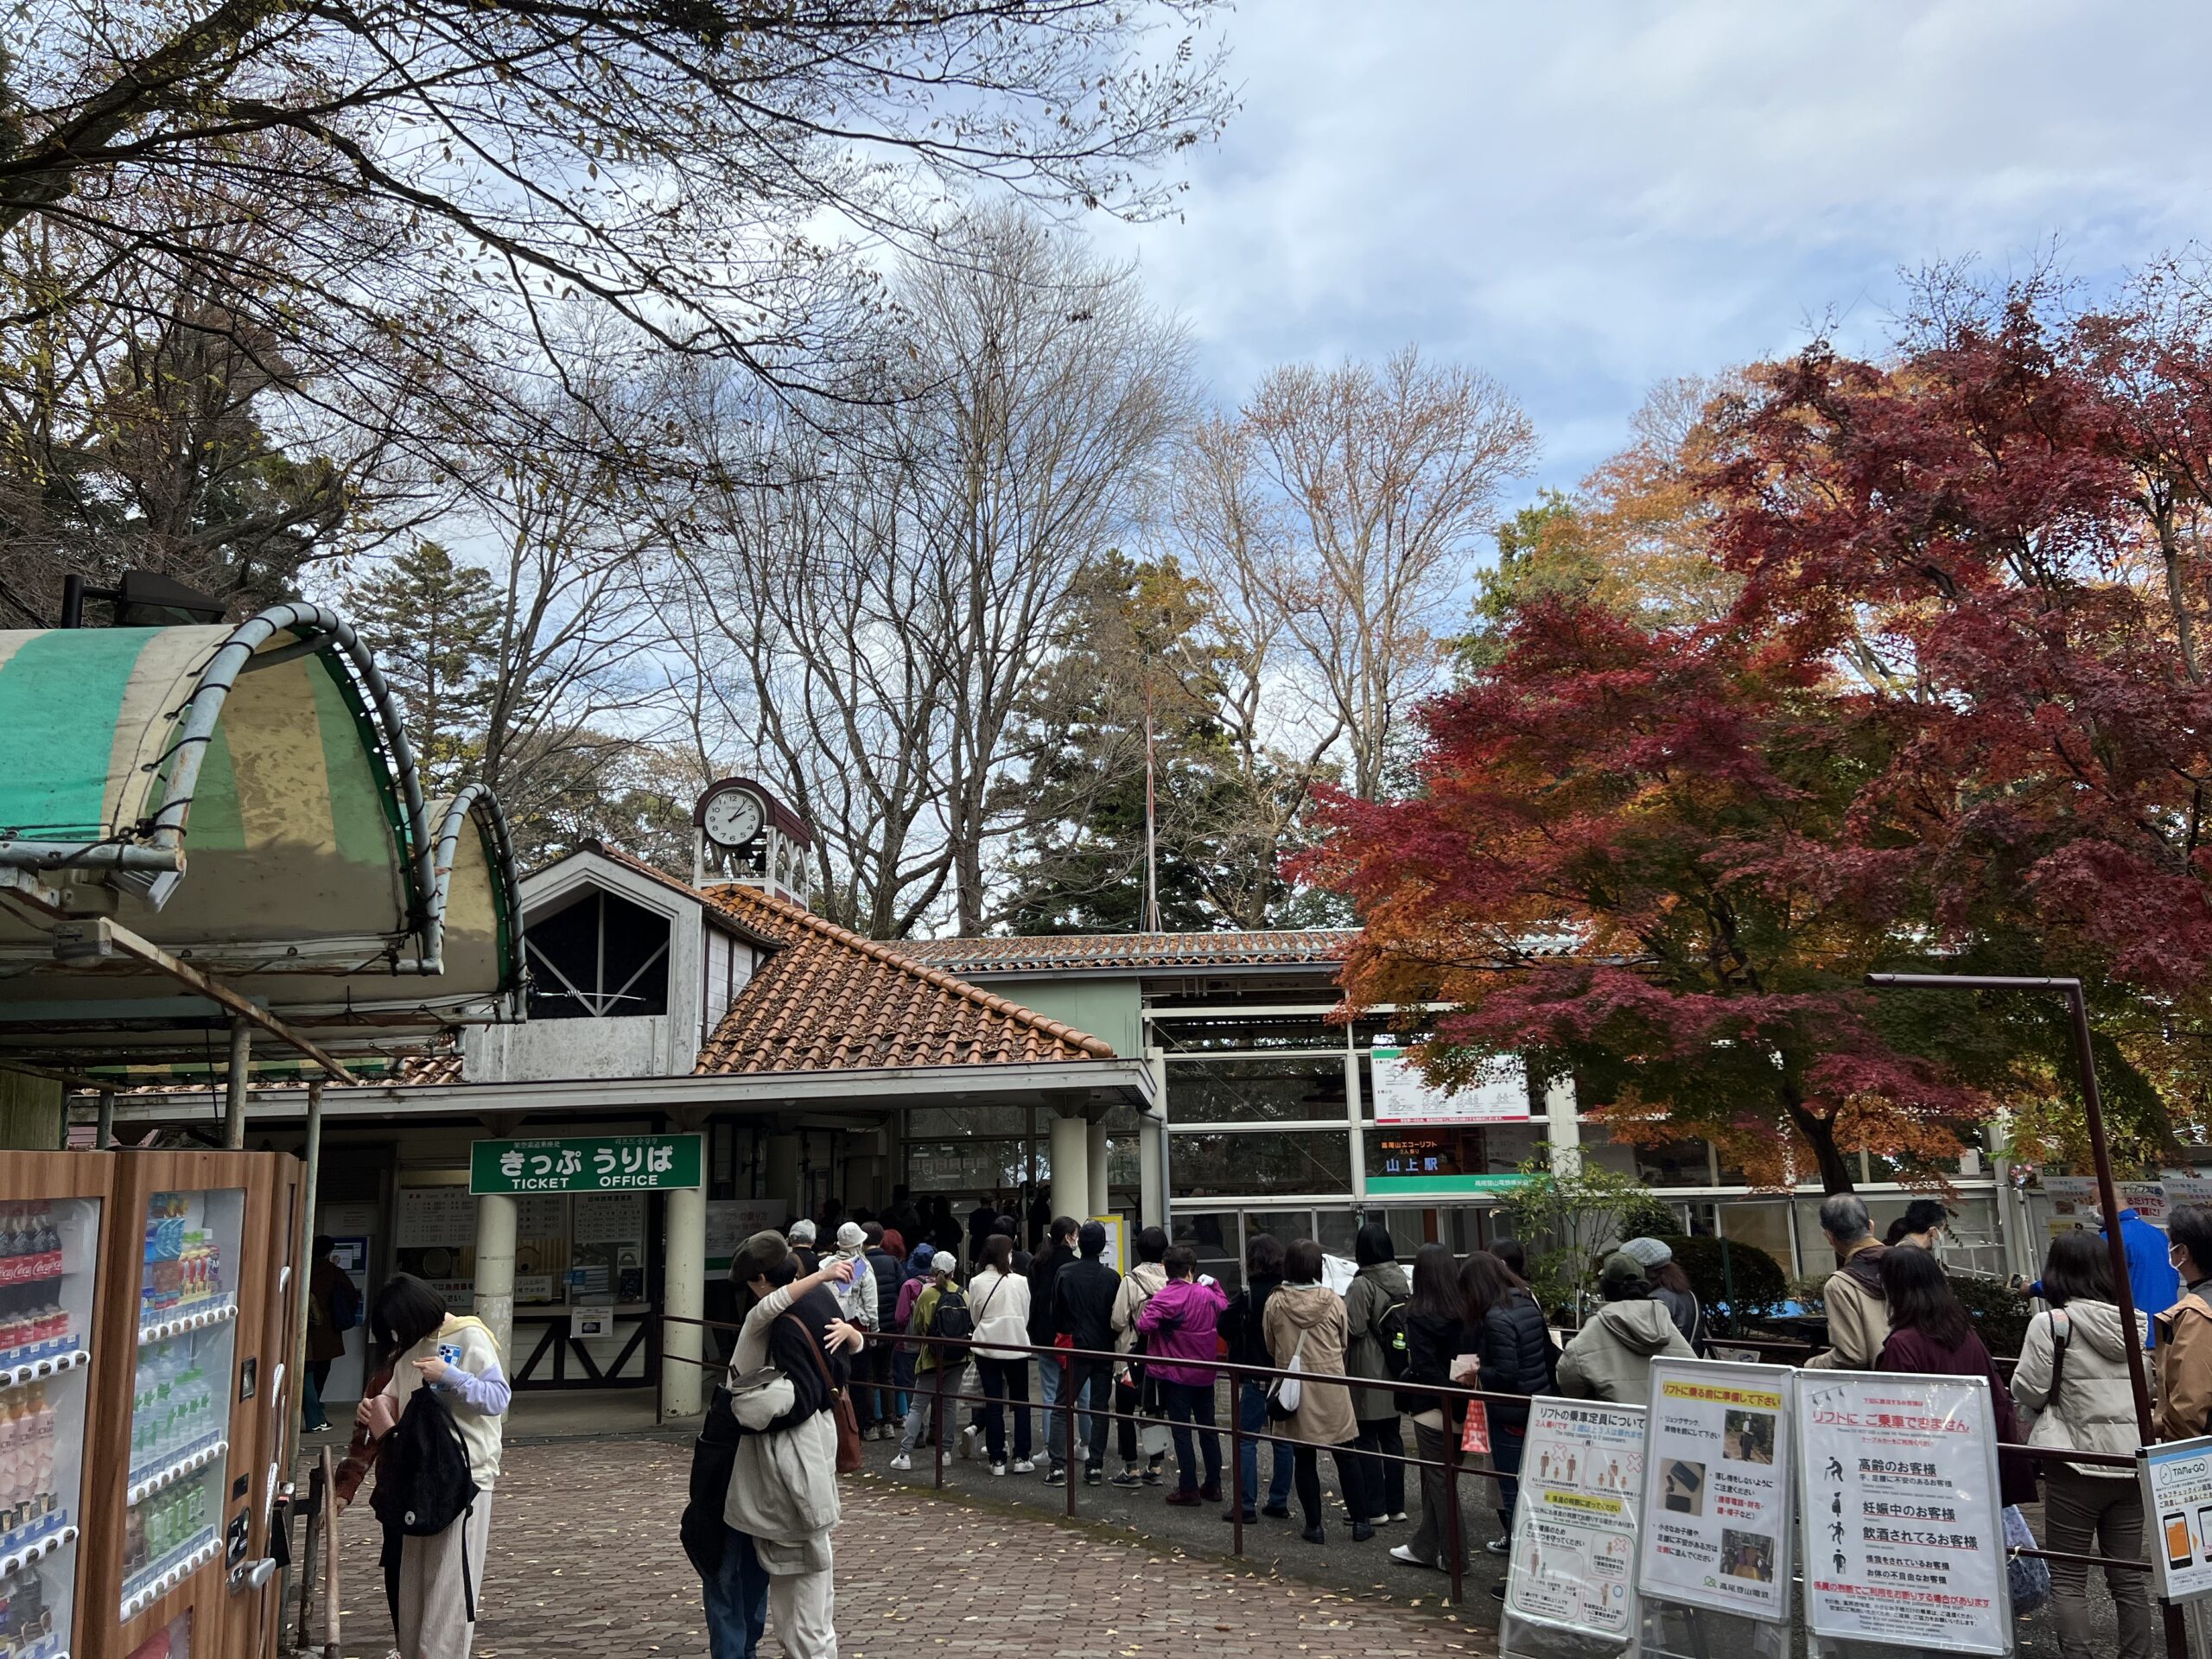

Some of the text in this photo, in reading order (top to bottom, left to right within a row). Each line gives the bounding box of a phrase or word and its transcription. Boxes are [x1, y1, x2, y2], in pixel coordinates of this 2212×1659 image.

[499, 1145, 673, 1177] きっぷ うりば
[1386, 1157, 1438, 1173] 山上駅
[512, 1174, 658, 1189] TICKET OFFICE
[1662, 1383, 1781, 1407] リフトに乗る前に準備して下さい
[1540, 1407, 1646, 1429] リフトの乗車定員について
[1813, 1410, 1859, 1425] リフトに
[1664, 1425, 1721, 1440] 荷物を前にして下さい
[1859, 1458, 1937, 1476] 高齢のお客様
[1713, 1482, 1756, 1496] ご注意ください
[1859, 1473, 1953, 1488] 手、足腰に不安のあるお客様
[1552, 1495, 1621, 1512] 係員の判断に従ってください
[1862, 1501, 1956, 1521] 妊娠中のお客様
[1527, 1522, 1566, 1535] 安確保のため
[1526, 1530, 1585, 1548] このつを守ってください
[1656, 1534, 1719, 1553] 足腰に不安がある方は
[1863, 1527, 1979, 1549] 飲酒されてるお客様
[1656, 1545, 1715, 1563] 左側に並んでください
[1866, 1554, 1950, 1570] 怪我をされているお客様
[1866, 1569, 1947, 1584] お体の不自由なお客様
[1719, 1582, 1770, 1599] 高尾登山電鉄
[1813, 1580, 1991, 1608] 係員の判断でご利用をお断りする場合があります
